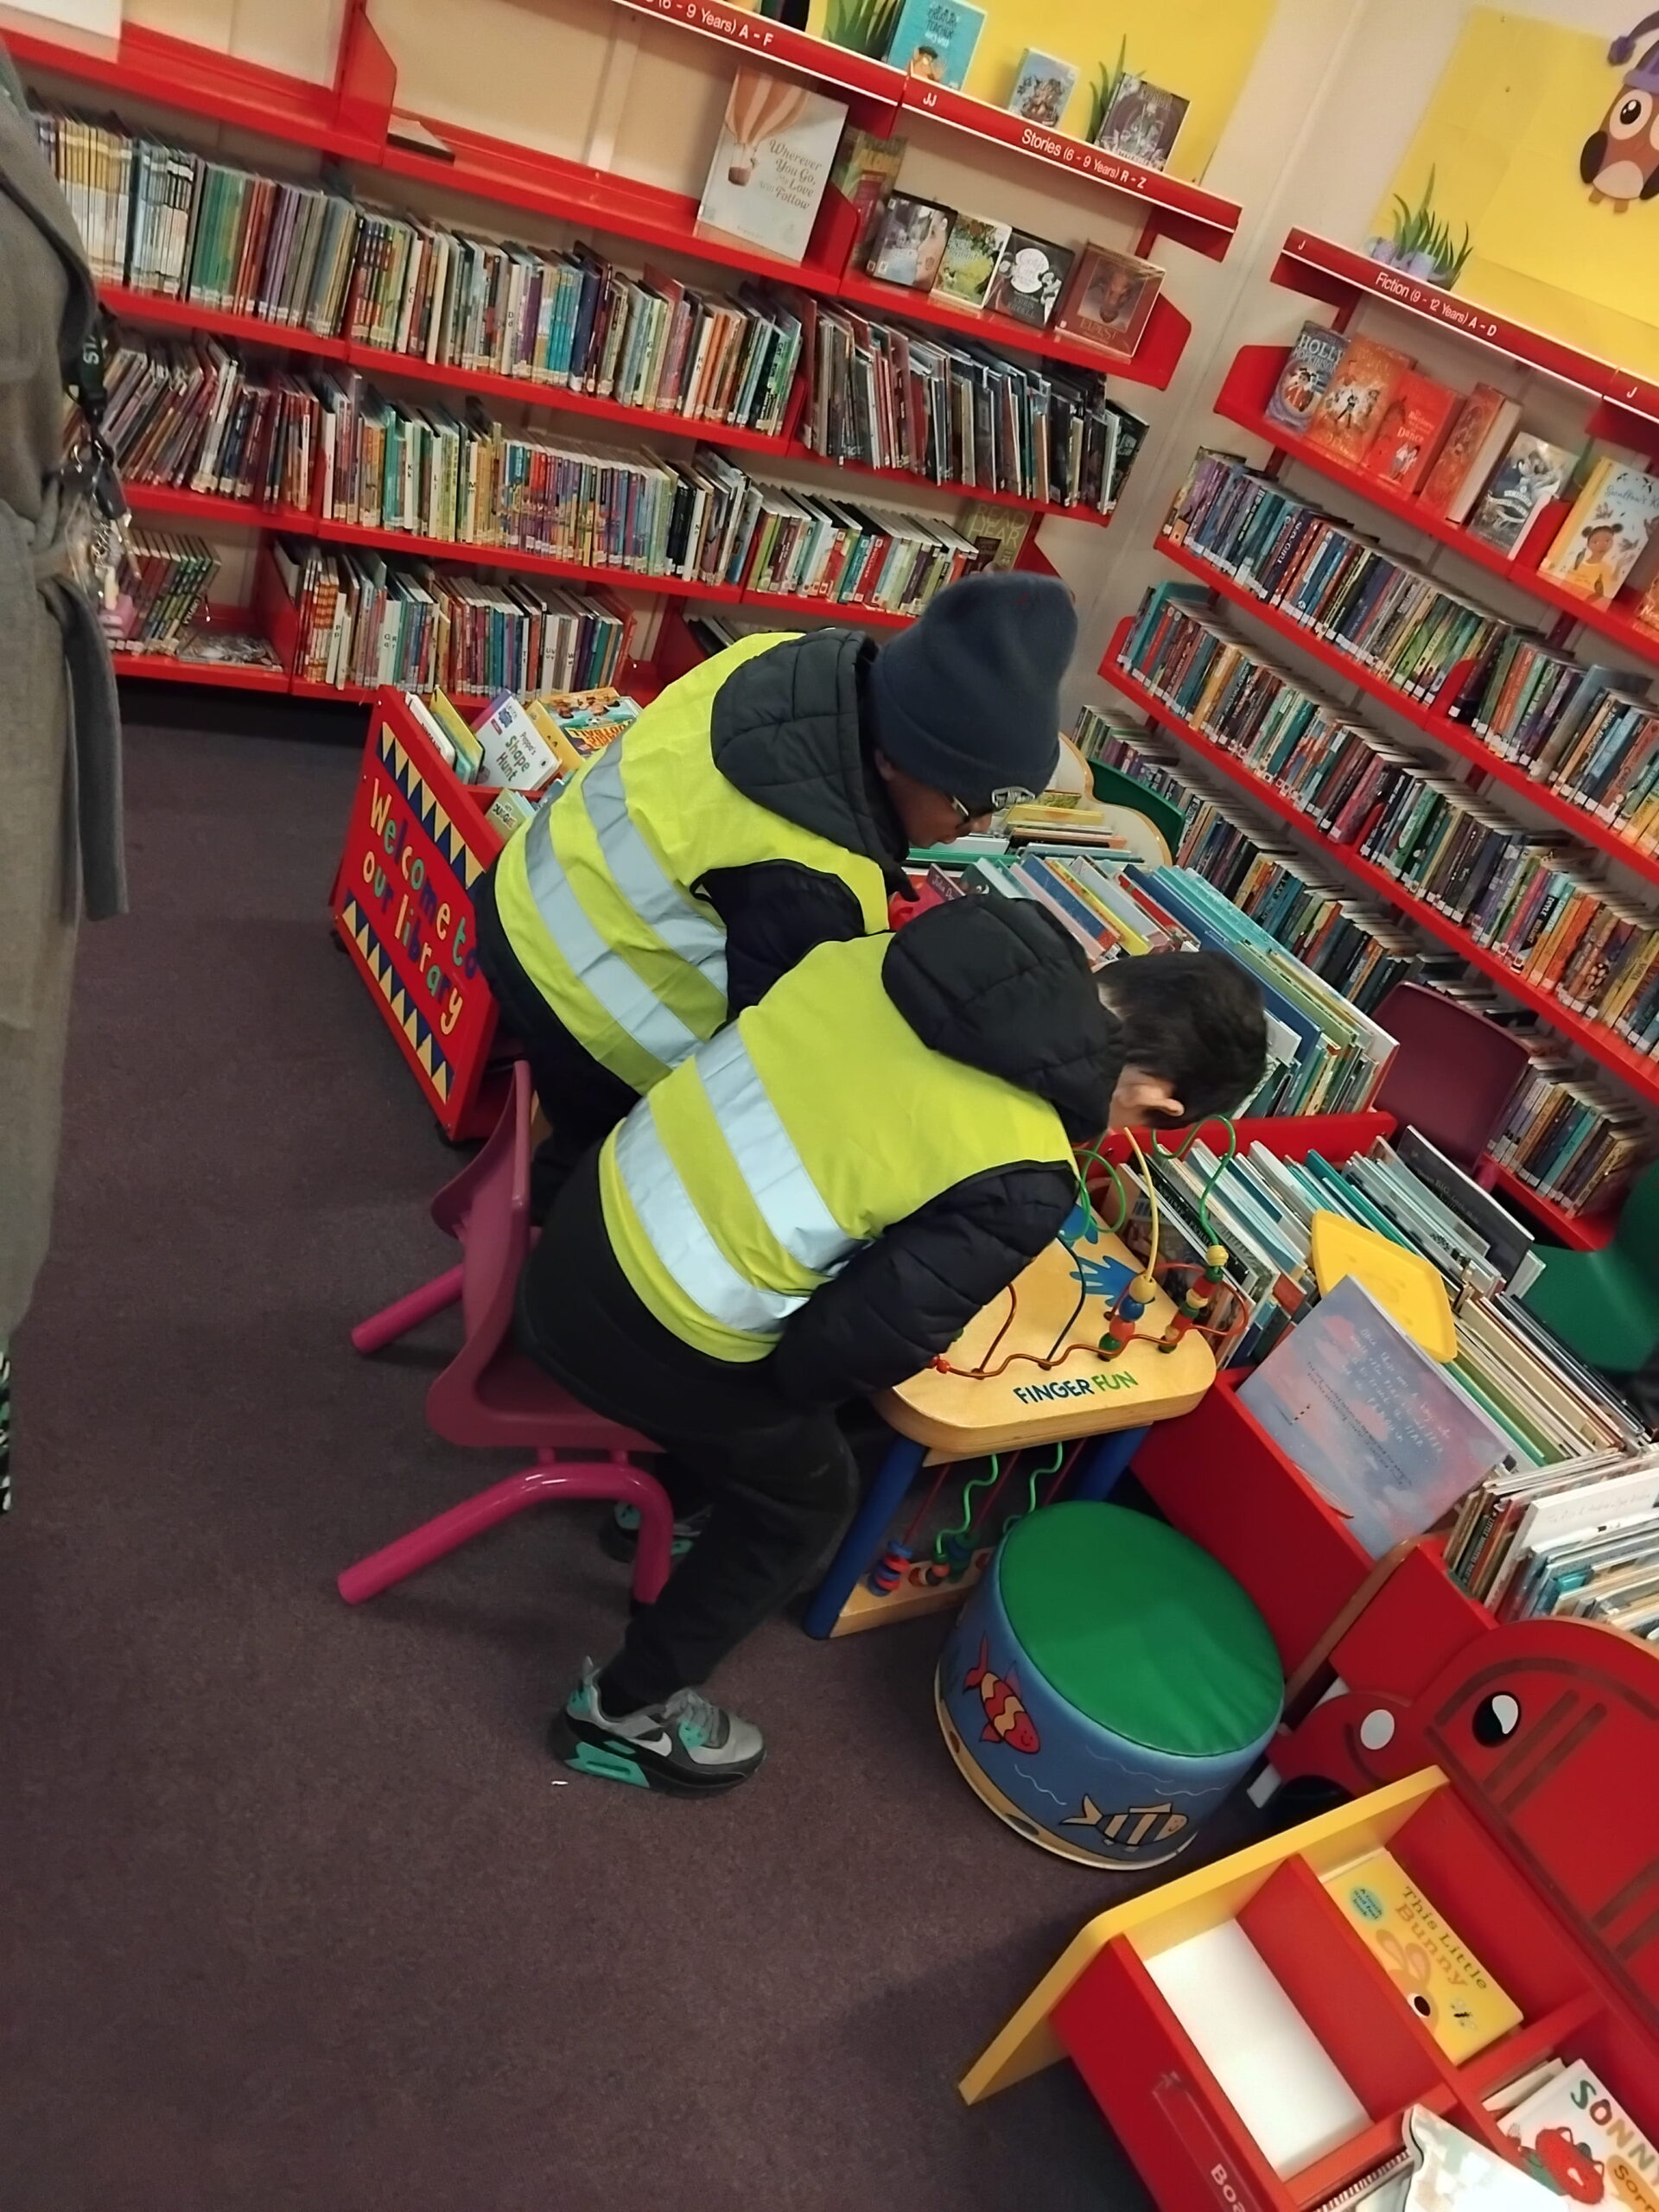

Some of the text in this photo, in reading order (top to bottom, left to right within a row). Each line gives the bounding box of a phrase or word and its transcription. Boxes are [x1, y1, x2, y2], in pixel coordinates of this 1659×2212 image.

[686, 3, 696, 18] 9
[701, 8, 737, 35] Years)
[739, 24, 749, 39] A
[763, 32, 774, 47] F
[923, 92, 938, 107] JJ
[769, 139, 823, 171] Wherever
[1021, 128, 1062, 156] Stories
[1063, 145, 1075, 162] (6
[1083, 155, 1092, 168] 9
[1093, 159, 1120, 180] Years)
[1120, 170, 1130, 183] R
[1137, 176, 1147, 189] Z
[775, 158, 817, 186] You Go,
[775, 186, 810, 210] Follow
[788, 180, 815, 197] Love
[1297, 238, 1306, 251] J
[1375, 270, 1411, 299] Fiction
[1410, 288, 1422, 303] (9
[1429, 297, 1441, 312] 12
[1440, 303, 1469, 326] Years)
[1468, 315, 1478, 328] A
[1486, 323, 1497, 338] D
[1298, 334, 1345, 365] HOLLY
[1626, 385, 1638, 399] J
[1396, 426, 1425, 443] Dance
[967, 513, 1020, 548] HEAR
[977, 504, 1027, 530] READ
[505, 734, 531, 773] Shape
[519, 731, 537, 756] Peppa's
[495, 752, 518, 783] Hunt
[369, 778, 452, 941] Welcome
[450, 915, 478, 979] to
[361, 849, 464, 1036] our library
[1012, 1370, 1140, 1407] FINGER FUN
[1351, 1897, 1370, 1918] book
[1353, 1888, 1380, 1921] and feel
[1394, 1902, 1470, 1988] Bunny
[1402, 1885, 1489, 1992] This Little
